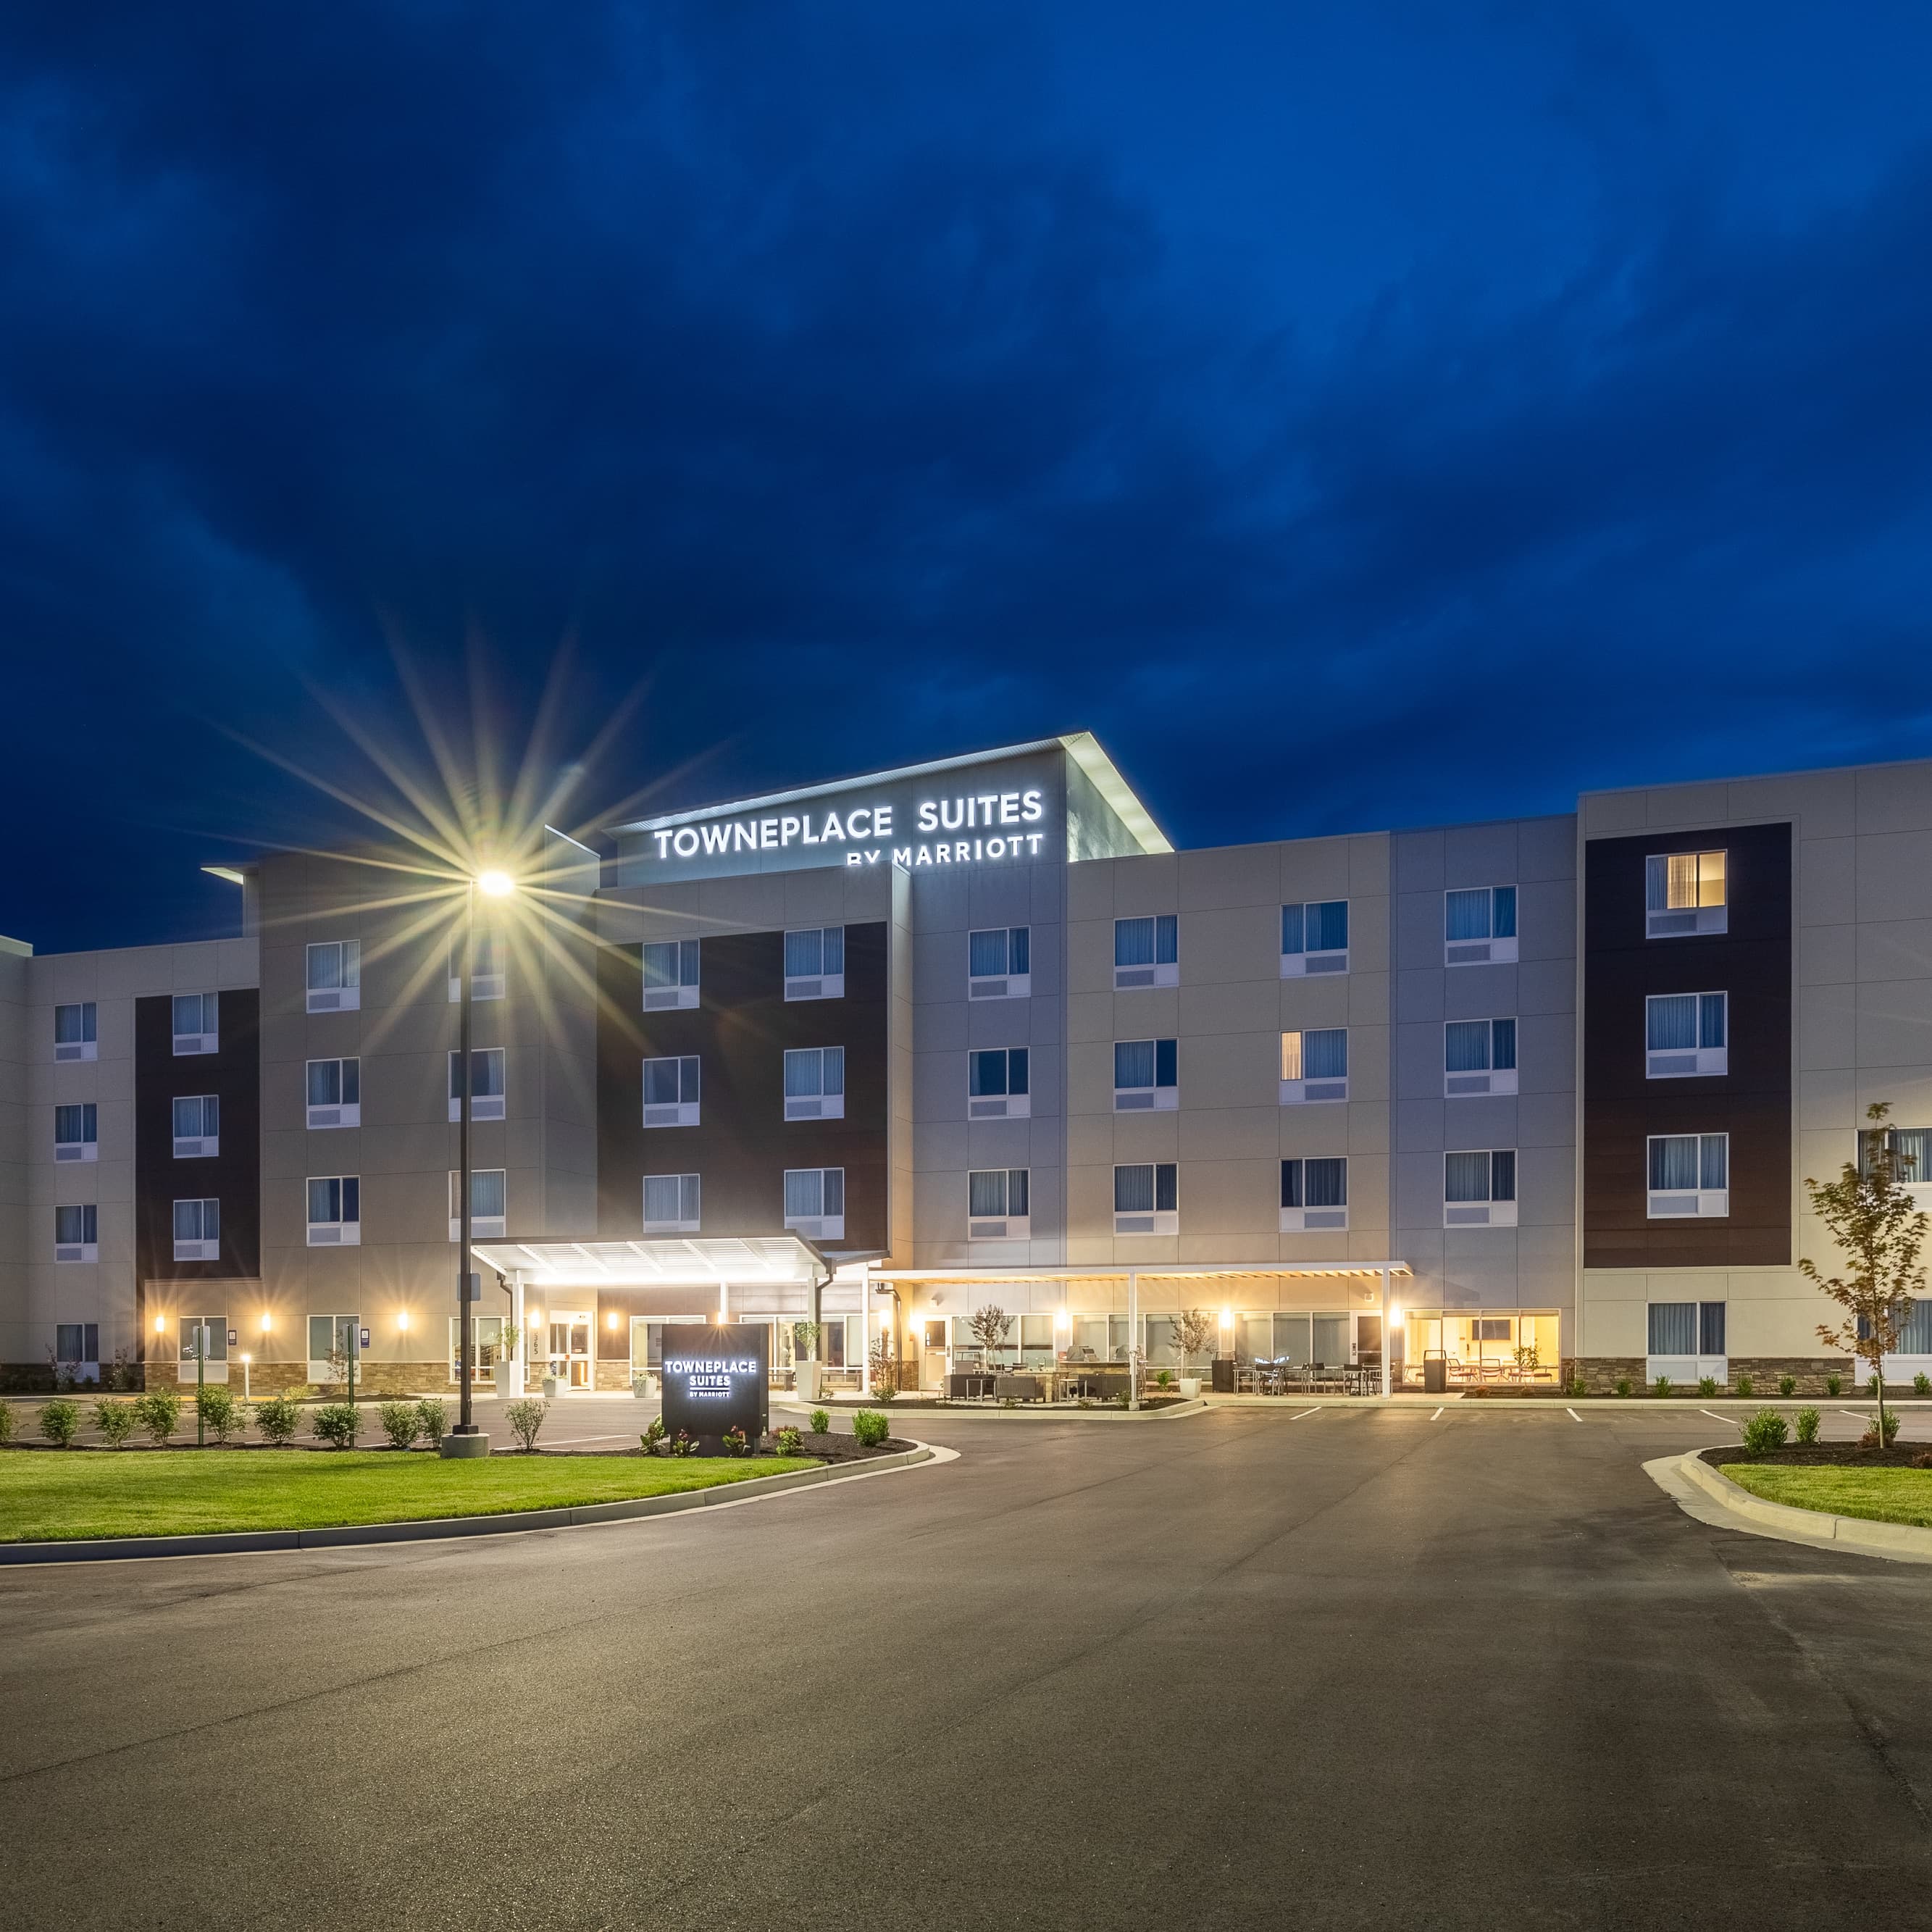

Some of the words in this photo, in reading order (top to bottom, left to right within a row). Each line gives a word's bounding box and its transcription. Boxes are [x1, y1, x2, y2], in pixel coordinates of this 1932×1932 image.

[654, 806, 892, 858] TOWNEPLACE
[918, 790, 1042, 832] SUITES
[847, 849, 881, 866] BY
[893, 833, 1043, 866] MARRIOTT
[664, 1360, 757, 1373] TOWNEPLACE
[689, 1375, 731, 1387] SUITES
